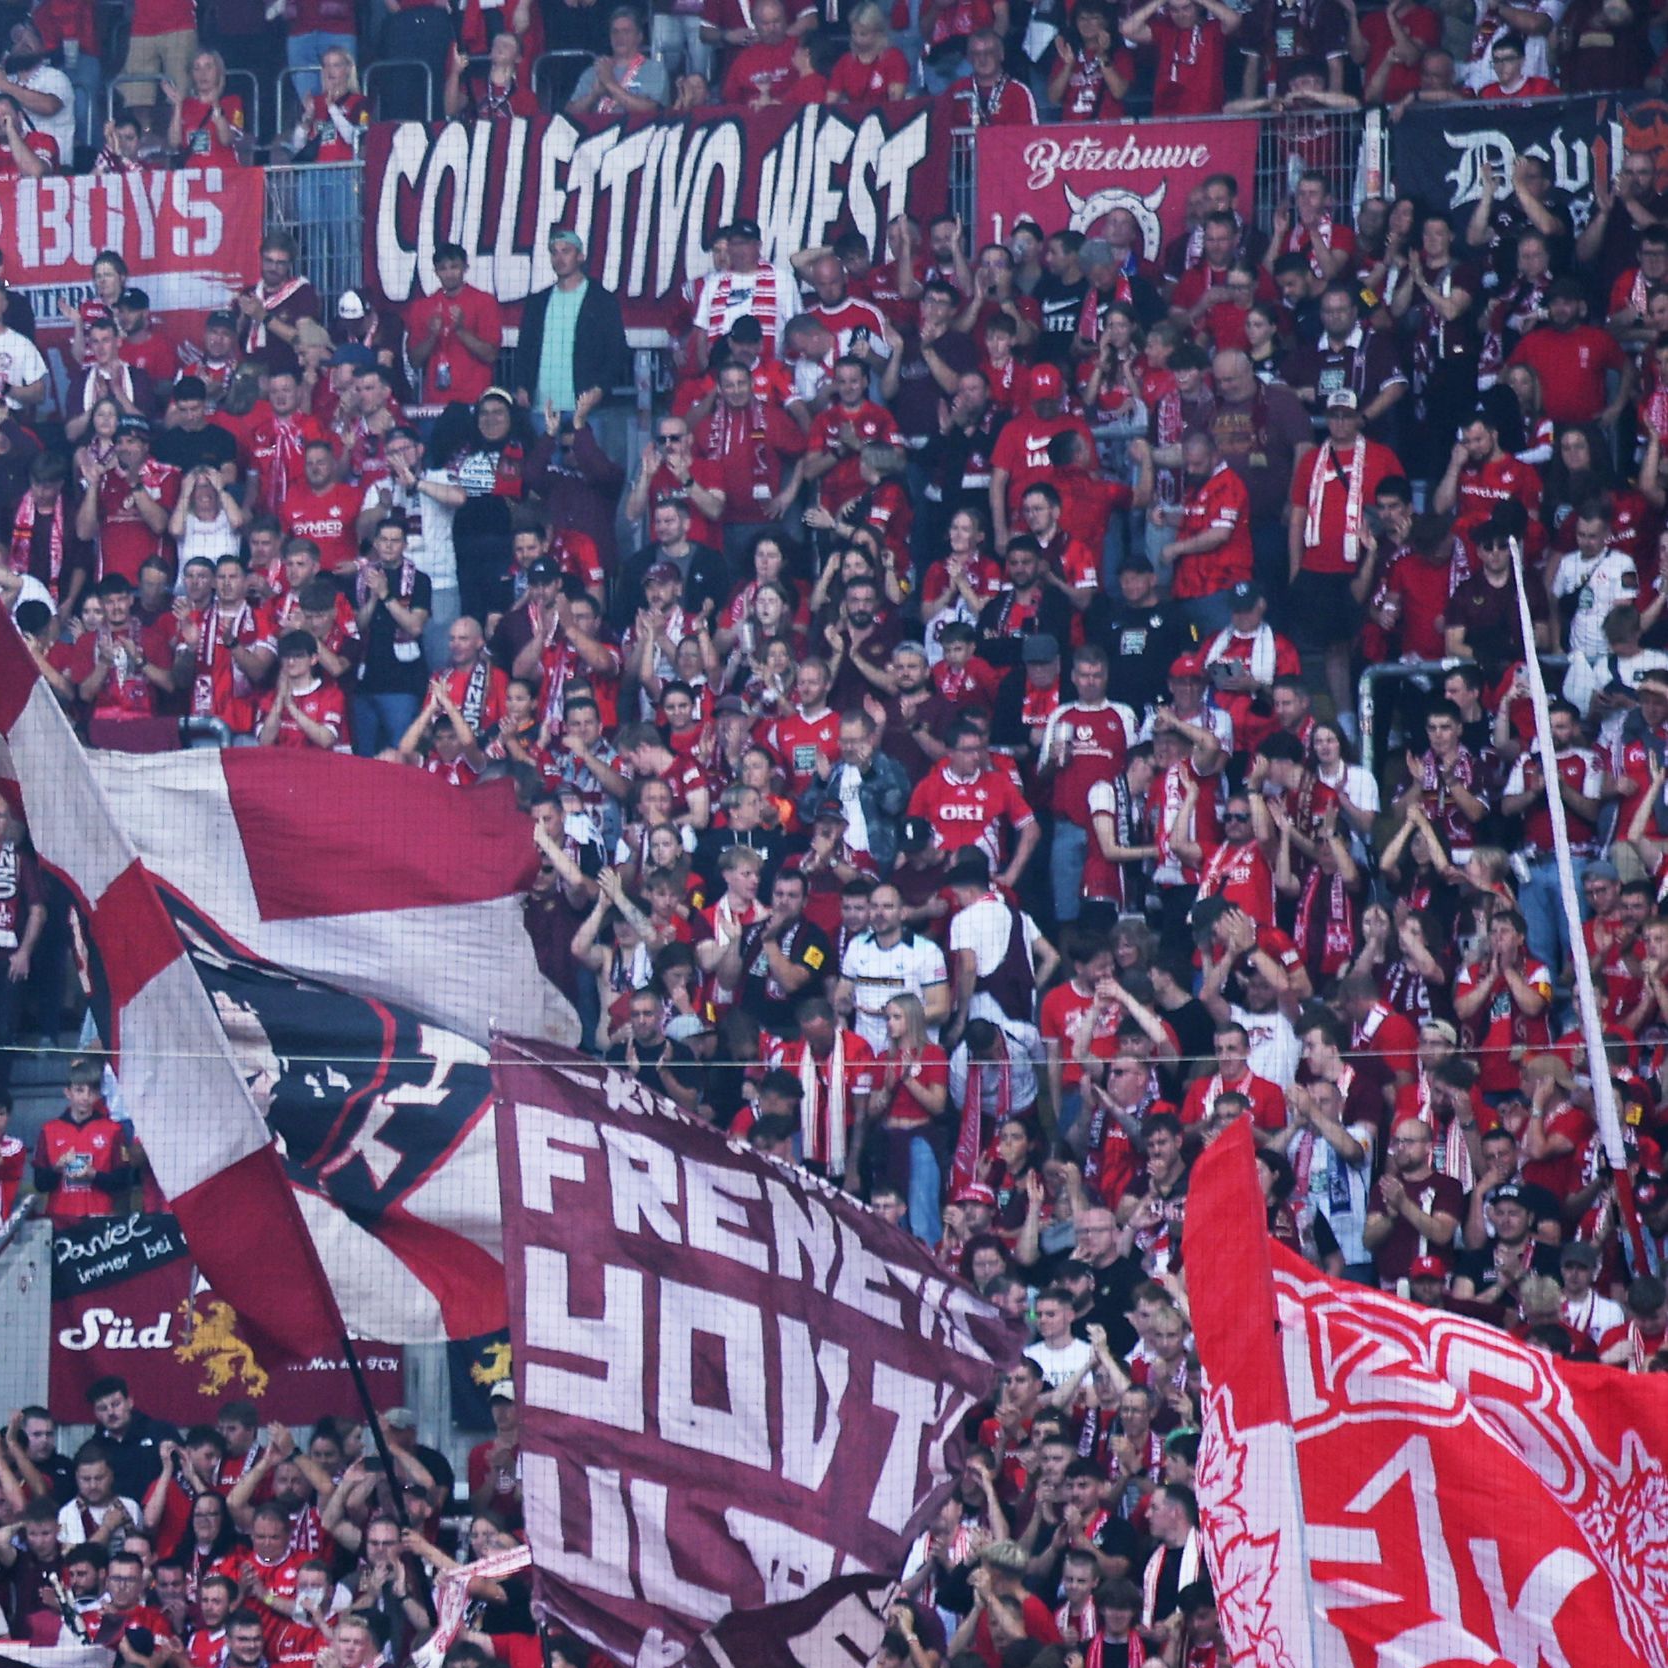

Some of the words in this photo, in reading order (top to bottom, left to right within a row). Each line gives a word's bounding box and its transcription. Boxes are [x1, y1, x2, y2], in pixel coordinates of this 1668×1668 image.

[1023, 137, 1210, 189] Betzebuwe
[15, 168, 225, 270] BOYS
[376, 114, 743, 301] COLLETTIVO
[753, 103, 929, 293] WEST
[1027, 450, 1052, 468] LAU
[939, 805, 984, 821] OKI
[54, 1211, 152, 1265] Daniel
[76, 1253, 133, 1285] immer
[143, 1233, 173, 1259] bei
[58, 1306, 174, 1352] Süd
